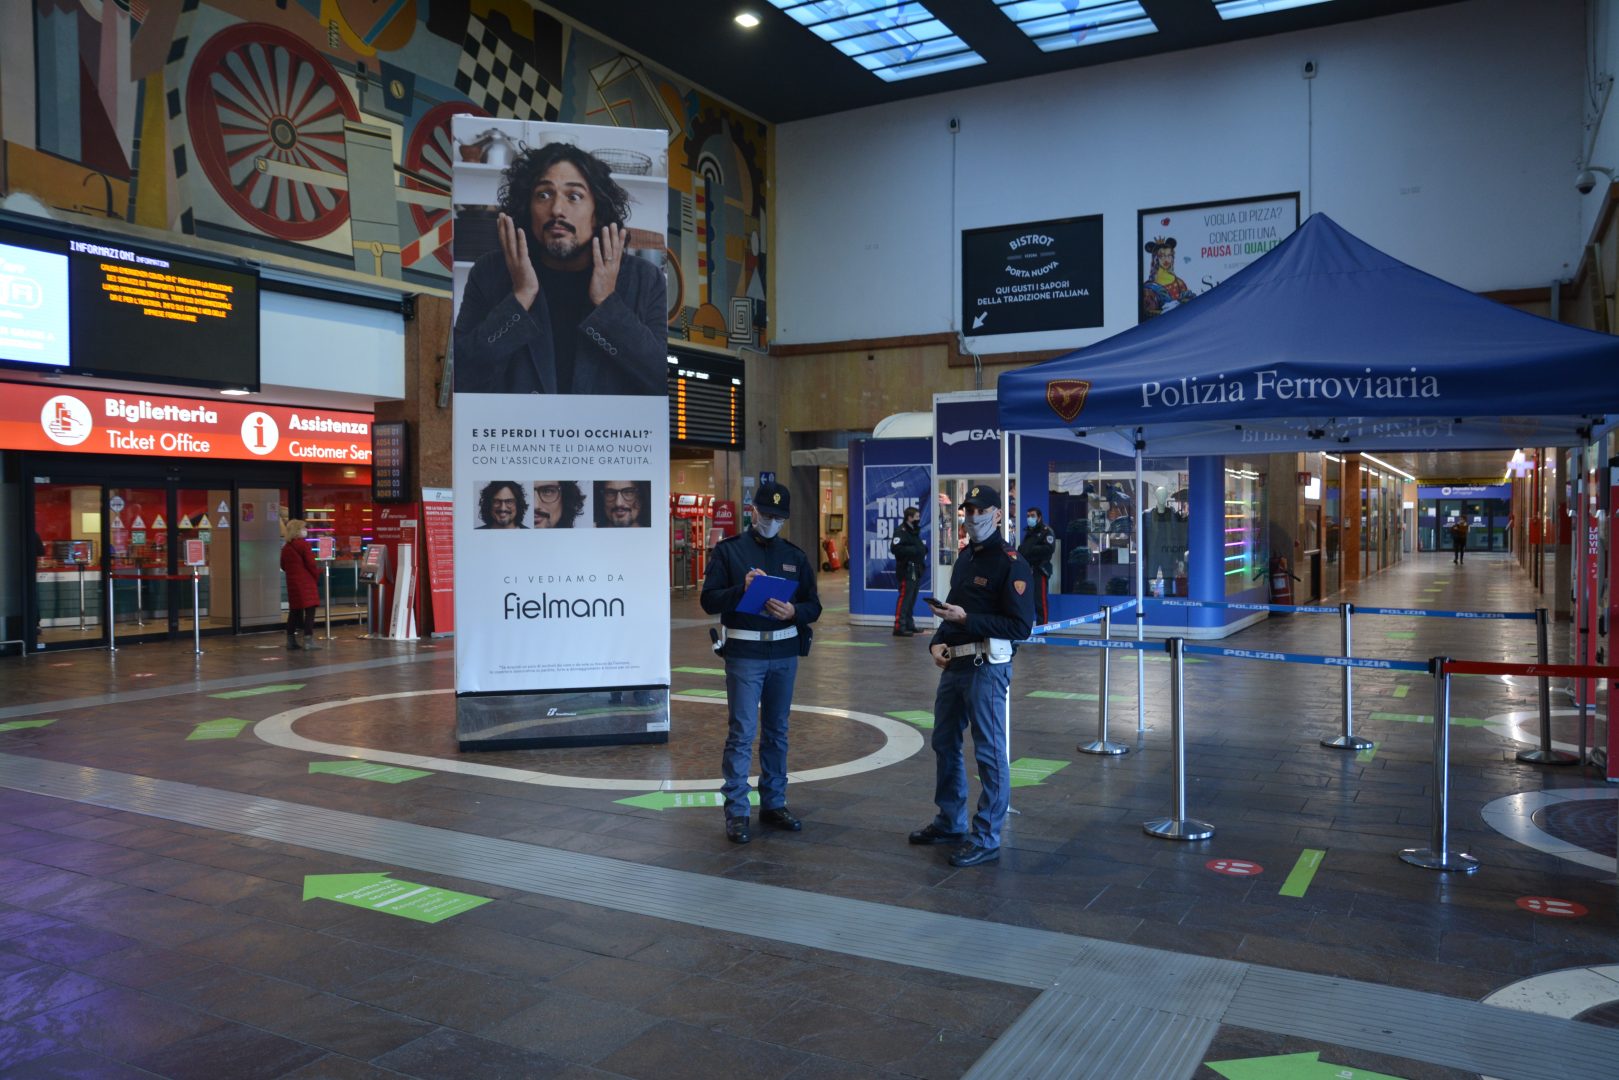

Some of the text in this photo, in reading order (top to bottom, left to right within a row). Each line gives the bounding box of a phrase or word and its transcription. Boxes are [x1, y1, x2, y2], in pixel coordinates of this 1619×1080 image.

[1204, 206, 1283, 227] VOGLIA DI PIZZA?
[1008, 234, 1054, 251] BISTROT
[1209, 226, 1276, 245] CONCEDITI UNA
[70, 240, 170, 268] INFORMAZIONI INFORMATION
[1201, 245, 1232, 259] PAUSA
[1234, 244, 1242, 256] DI
[1004, 260, 1060, 278] PORTA NUOVA
[996, 286, 1010, 295] QUI
[1011, 283, 1035, 293] GUSTI
[1039, 280, 1070, 290] SAPORI
[977, 288, 1090, 306] DELLA TRADIZIONE ITALIANA
[1140, 367, 1441, 408] Polizia Ferroviaria
[105, 398, 218, 424] Biglietteria
[288, 414, 368, 435] Assistenza
[472, 428, 478, 438] E
[482, 428, 498, 438] SE
[502, 428, 537, 438] PERDI
[549, 429, 580, 438] TUOI
[106, 430, 211, 453] Ticket Office
[289, 440, 348, 459] Customer
[472, 444, 652, 453] DA FIELMANN TE LI DIAMO NUOVI
[472, 456, 653, 466] CON L'ASSICURAZIONE GRATUITA.
[504, 574, 626, 584] CI VEDIAMO DA
[504, 592, 625, 620] fielmann
[1078, 639, 1134, 648] POLIZIA
[1224, 649, 1286, 661] POLIZIA
[1324, 657, 1390, 668] POLIZIA
